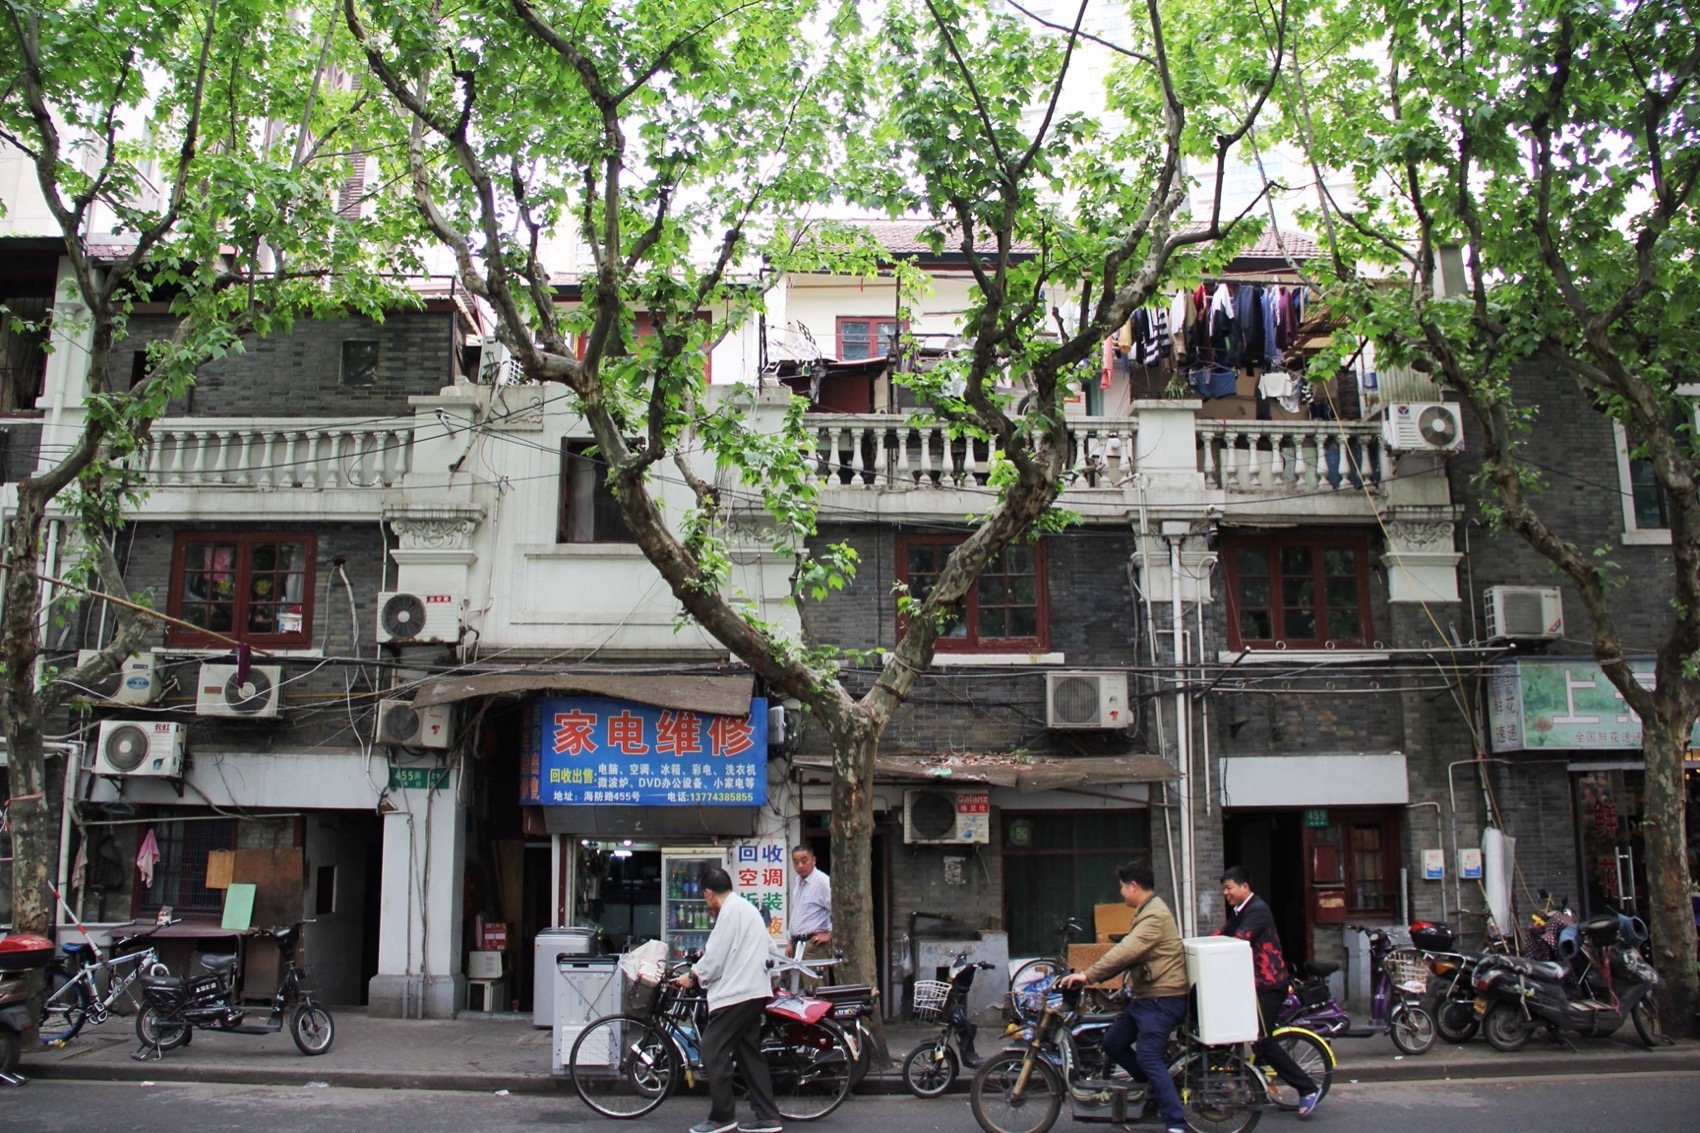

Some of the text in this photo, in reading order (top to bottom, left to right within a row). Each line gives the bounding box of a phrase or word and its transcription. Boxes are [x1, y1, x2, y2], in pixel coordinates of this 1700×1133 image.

[552, 709, 755, 756] 家电维修
[958, 795, 988, 803] Galanz
[1309, 810, 1326, 820] 459
[739, 845, 783, 863] 回收
[739, 869, 783, 887] 空调
[112, 962, 146, 999] FOREVR
